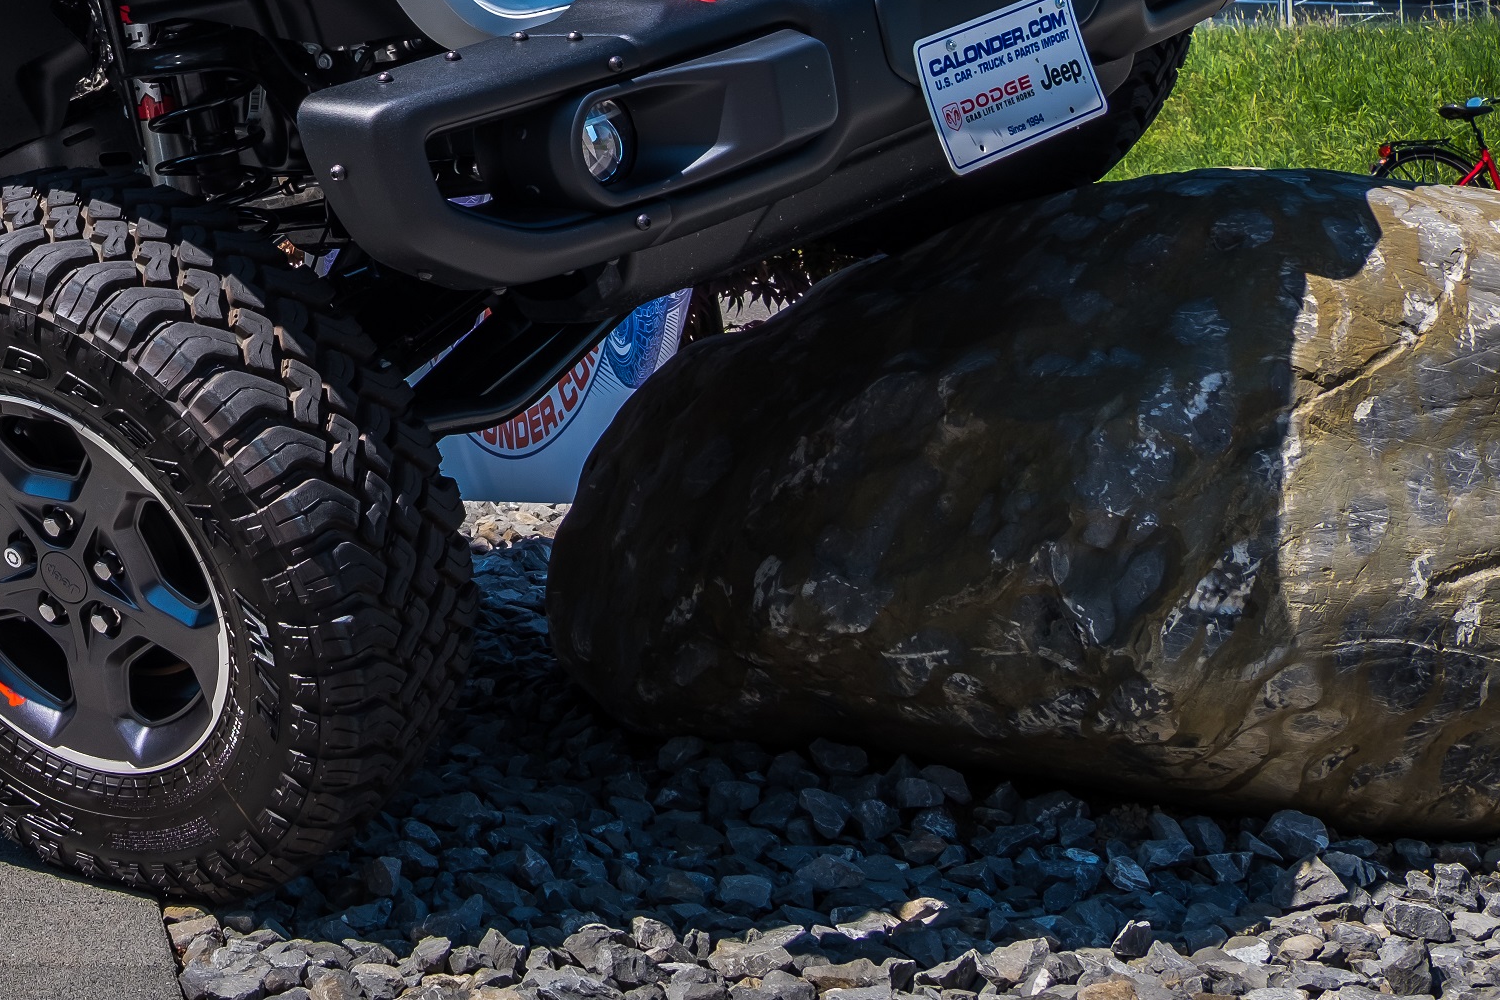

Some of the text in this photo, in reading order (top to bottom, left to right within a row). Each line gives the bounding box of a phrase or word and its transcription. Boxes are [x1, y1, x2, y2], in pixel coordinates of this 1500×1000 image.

[928, 9, 1067, 78] CALONDER.COM
[935, 75, 954, 91] U.S.
[954, 67, 973, 85] CAR
[977, 55, 1007, 75] TRUCK
[1007, 52, 1014, 63] &
[1014, 42, 1041, 61] PARTS
[1040, 28, 1071, 50] IMPORT
[1040, 58, 1083, 91] Jeep
[959, 74, 1033, 115] DODGE
[965, 89, 1036, 124] GRAB LIFE BY THE HORNS
[1007, 113, 1045, 137] Since 1994
[45, 563, 81, 595] Jeep
[232, 588, 281, 744] M/T
